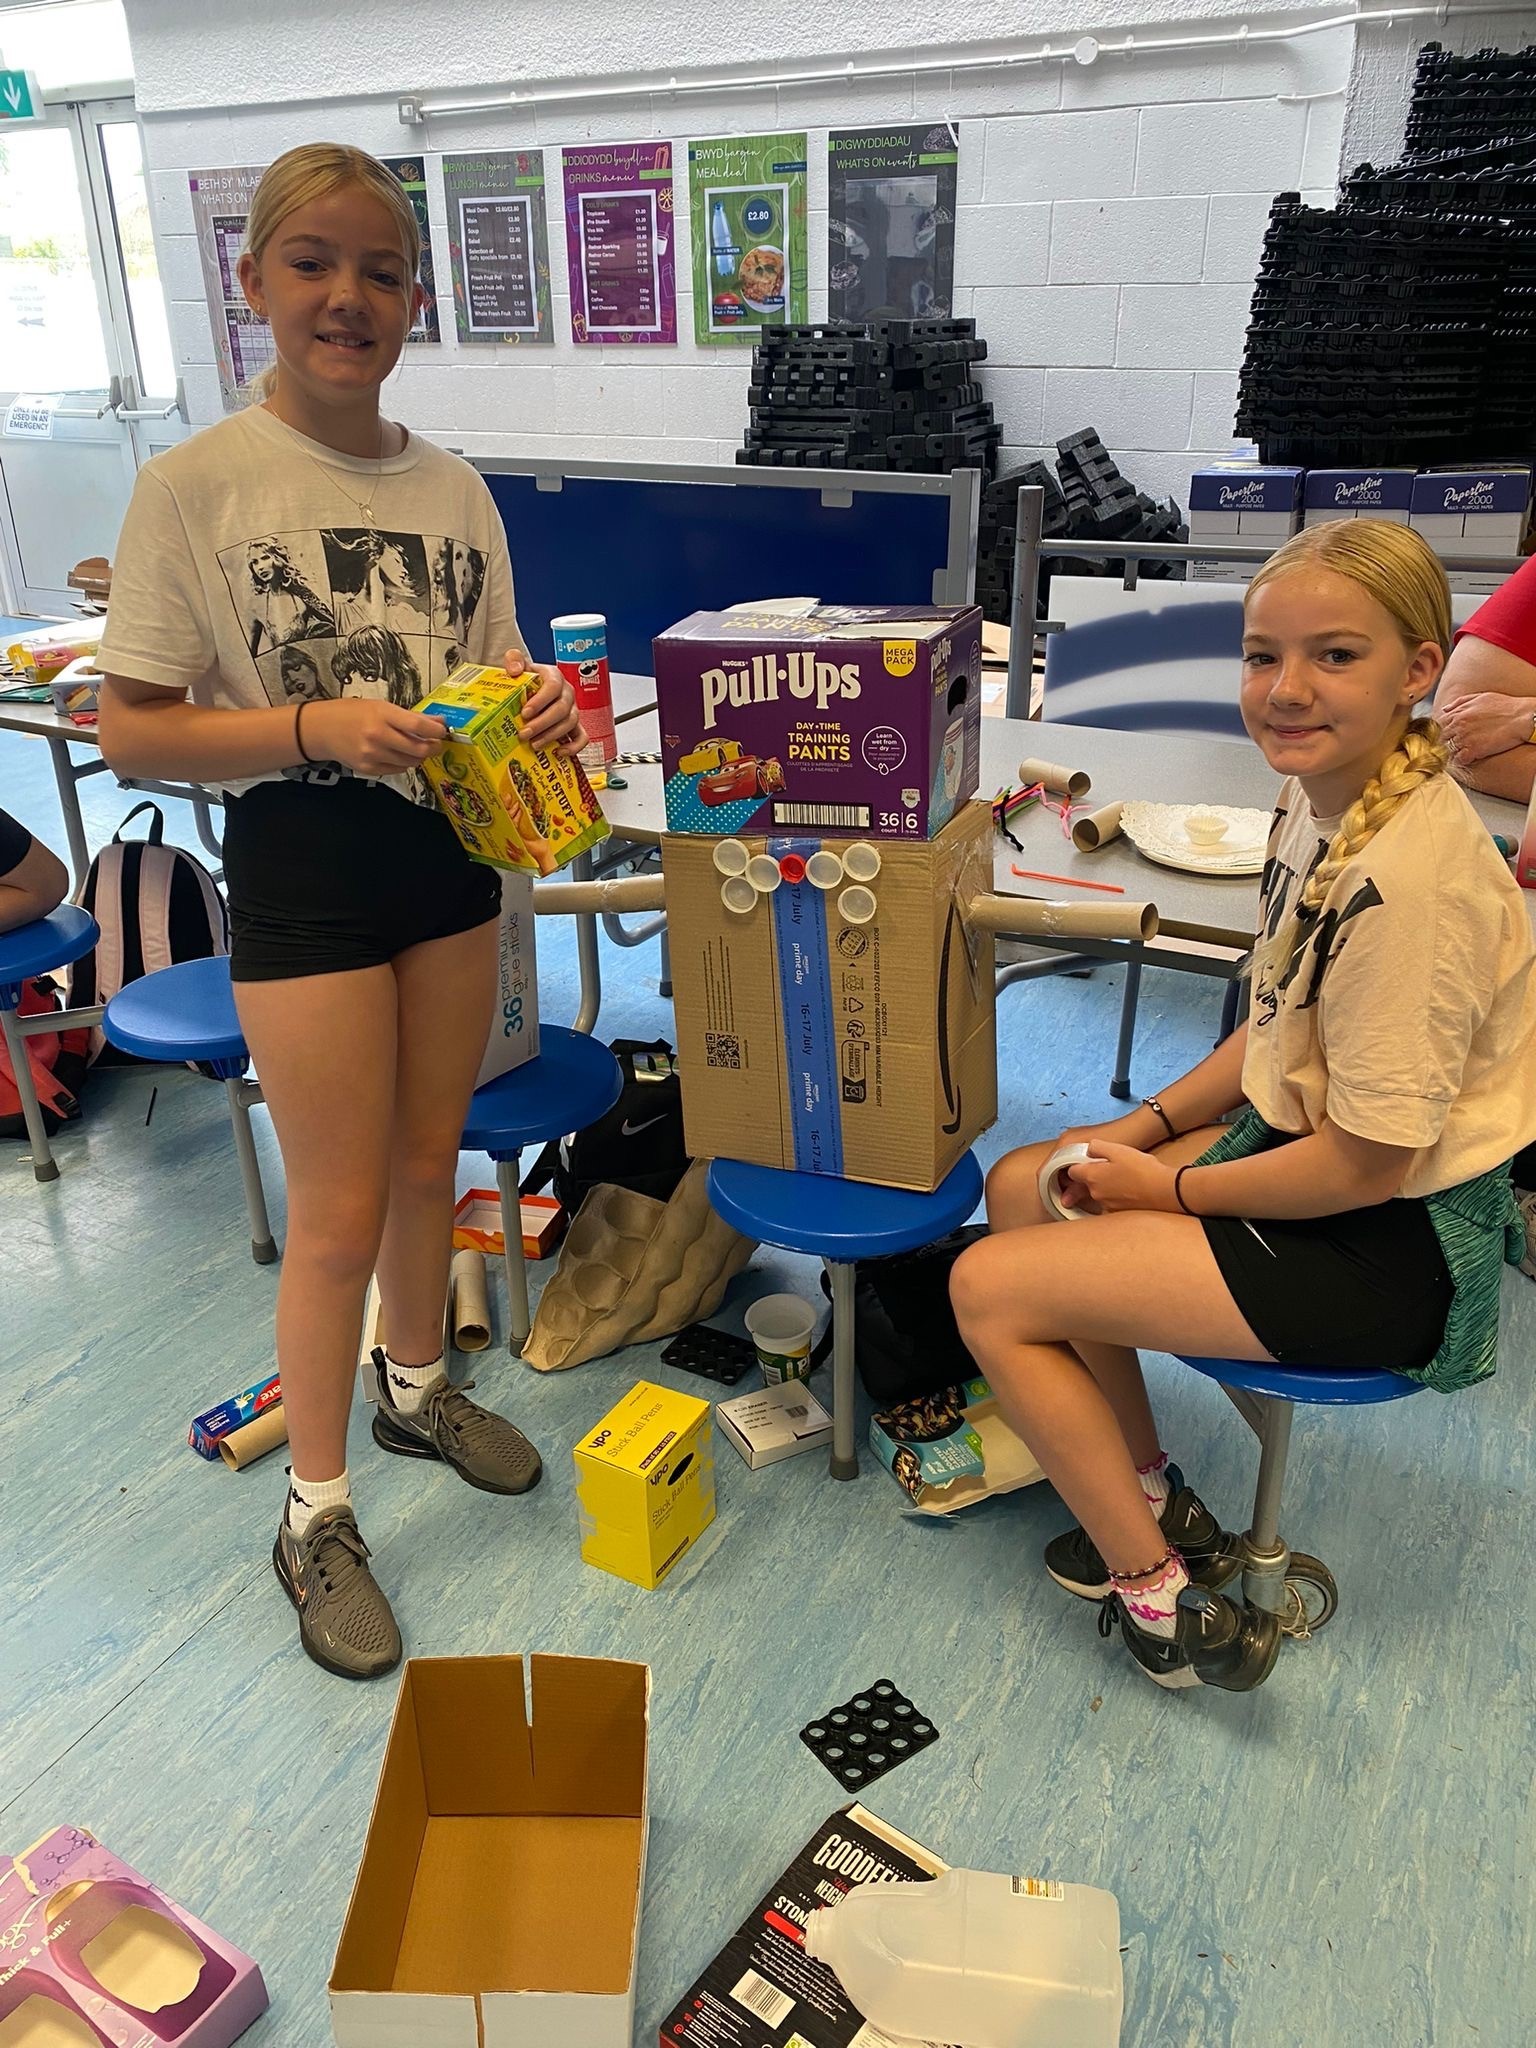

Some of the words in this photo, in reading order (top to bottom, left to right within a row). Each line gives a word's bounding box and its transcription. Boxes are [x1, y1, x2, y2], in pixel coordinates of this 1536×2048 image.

[836, 136, 911, 151] DIGWYDDIADAU
[568, 154, 613, 166] DDIODYDD
[695, 148, 723, 160] BWYD
[723, 143, 761, 165] bargen
[836, 158, 870, 169] WHAT'S
[871, 157, 886, 167] ON
[887, 151, 918, 169] events
[449, 161, 487, 173] BWYDLEN
[696, 166, 722, 178] MEAL
[722, 161, 747, 181] deal
[199, 178, 220, 190] BETH
[450, 179, 477, 190] LUNCH
[569, 172, 601, 184] DRINKS
[602, 173, 635, 182] menu
[201, 193, 232, 204] WHAT'S
[234, 192, 247, 203] ON
[748, 211, 769, 221] £2.80
[9, 420, 49, 431] EMERGENCY
[12, 411, 30, 421] USED
[30, 413, 38, 422] IN
[39, 414, 49, 422] AN
[1219, 481, 1265, 504] Paperline
[1334, 477, 1382, 501] Paperline
[1357, 490, 1381, 500] 2000
[1443, 481, 1495, 507] Paperline
[1241, 494, 1264, 504] 2000
[1468, 495, 1493, 505] 2000
[886, 648, 914, 656] MEGA
[886, 656, 915, 665] PACK
[503, 715, 519, 736] SMOKY
[787, 732, 851, 744] TRAINING
[788, 745, 851, 761] PANTS
[879, 812, 900, 826] 36
[905, 813, 918, 829] 6
[791, 901, 803, 925] July
[508, 912, 521, 956] sticks
[792, 942, 802, 969] prime
[511, 957, 524, 995] glue
[795, 968, 804, 985] day
[503, 996, 523, 1038] 36
[800, 1003, 811, 1031] 16-17
[803, 1034, 814, 1055] July
[803, 1072, 813, 1098] prime
[805, 1097, 814, 1112] day
[810, 1130, 821, 1157] 16-17
[812, 1158, 823, 1172] Jul
[588, 1429, 612, 1449] ypo
[606, 1437, 631, 1458] Stick
[625, 1420, 645, 1438] Ball
[642, 1402, 663, 1421] Pens
[933, 1446, 956, 1471] ROASTED
[943, 1449, 961, 1469] GARLIC
[947, 1447, 967, 1467] BUTTER
[650, 1463, 669, 1486] ypo
[652, 1499, 671, 1523] Stick
[671, 1479, 687, 1503] Ball
[685, 1463, 701, 1486] Pens
[31, 1947, 43, 1958] &
[41, 1919, 73, 1947] Full+
